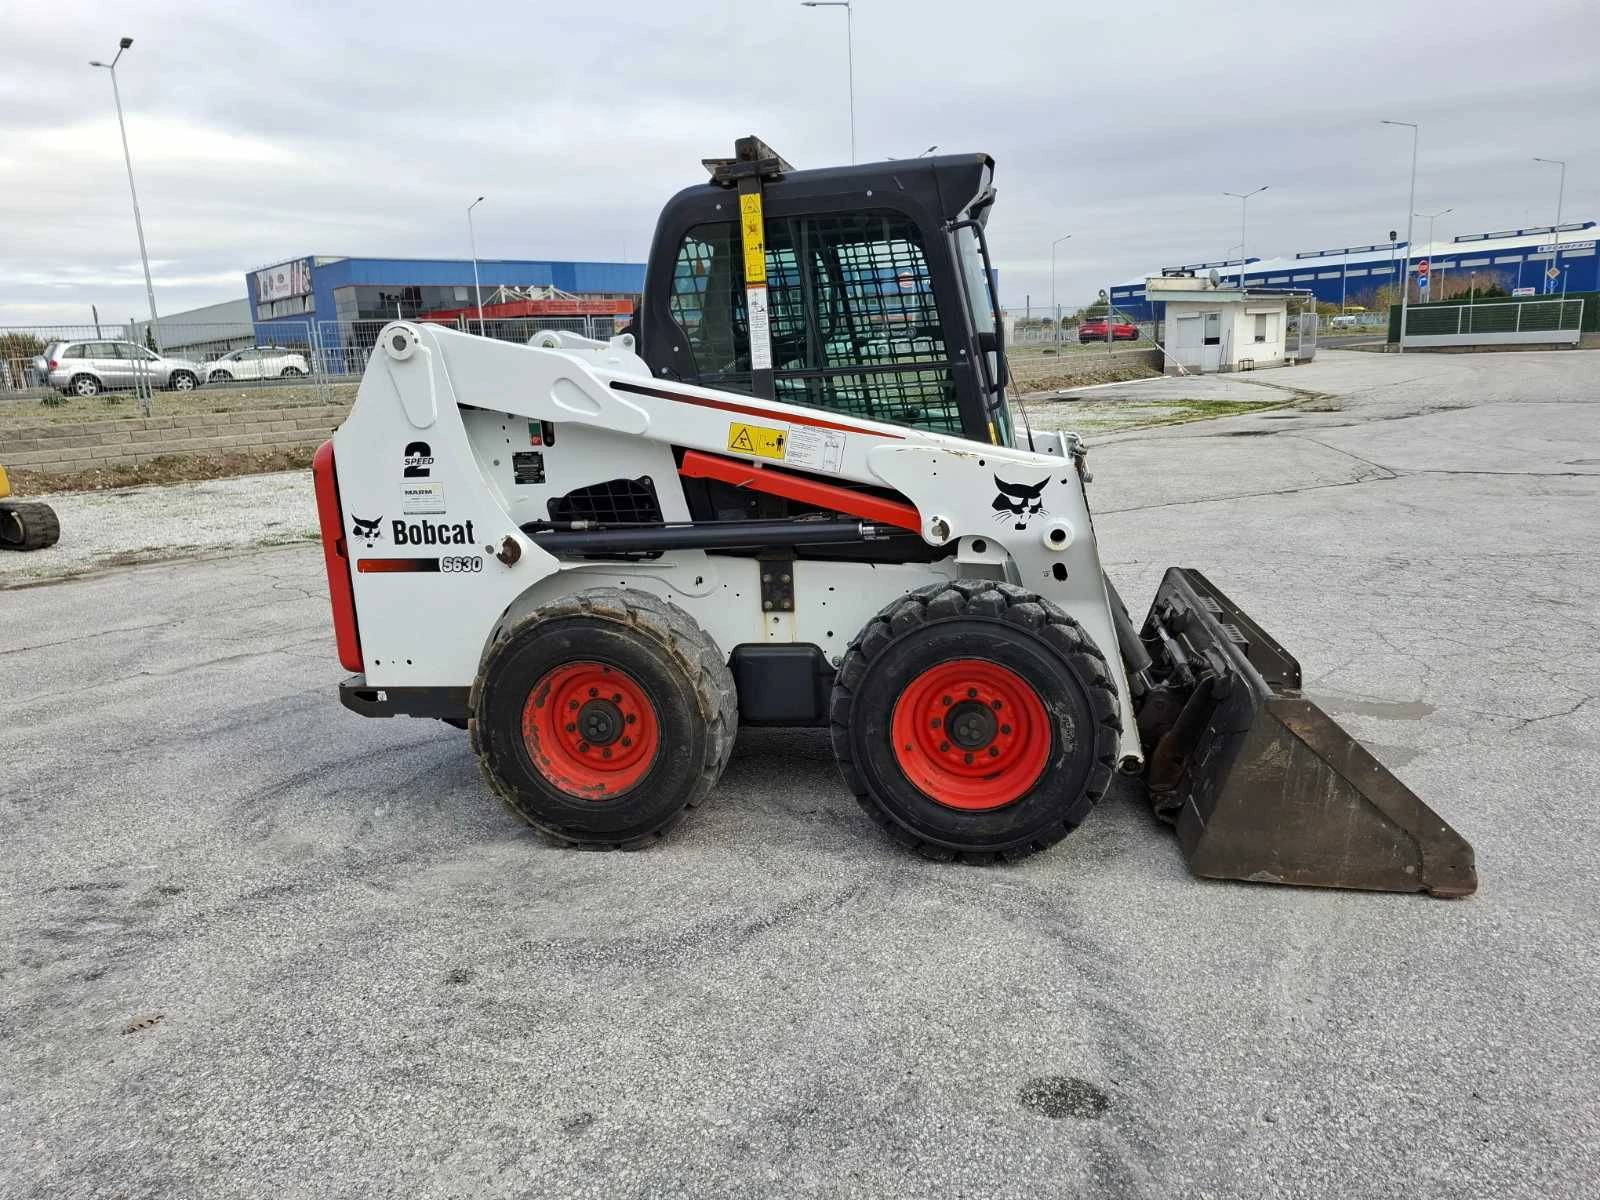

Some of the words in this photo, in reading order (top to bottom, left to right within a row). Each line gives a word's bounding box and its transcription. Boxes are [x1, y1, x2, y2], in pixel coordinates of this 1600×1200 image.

[404, 441, 431, 478] 2
[404, 457, 434, 466] SPEED
[392, 520, 475, 545] Bobcat
[442, 556, 483, 573] S630
